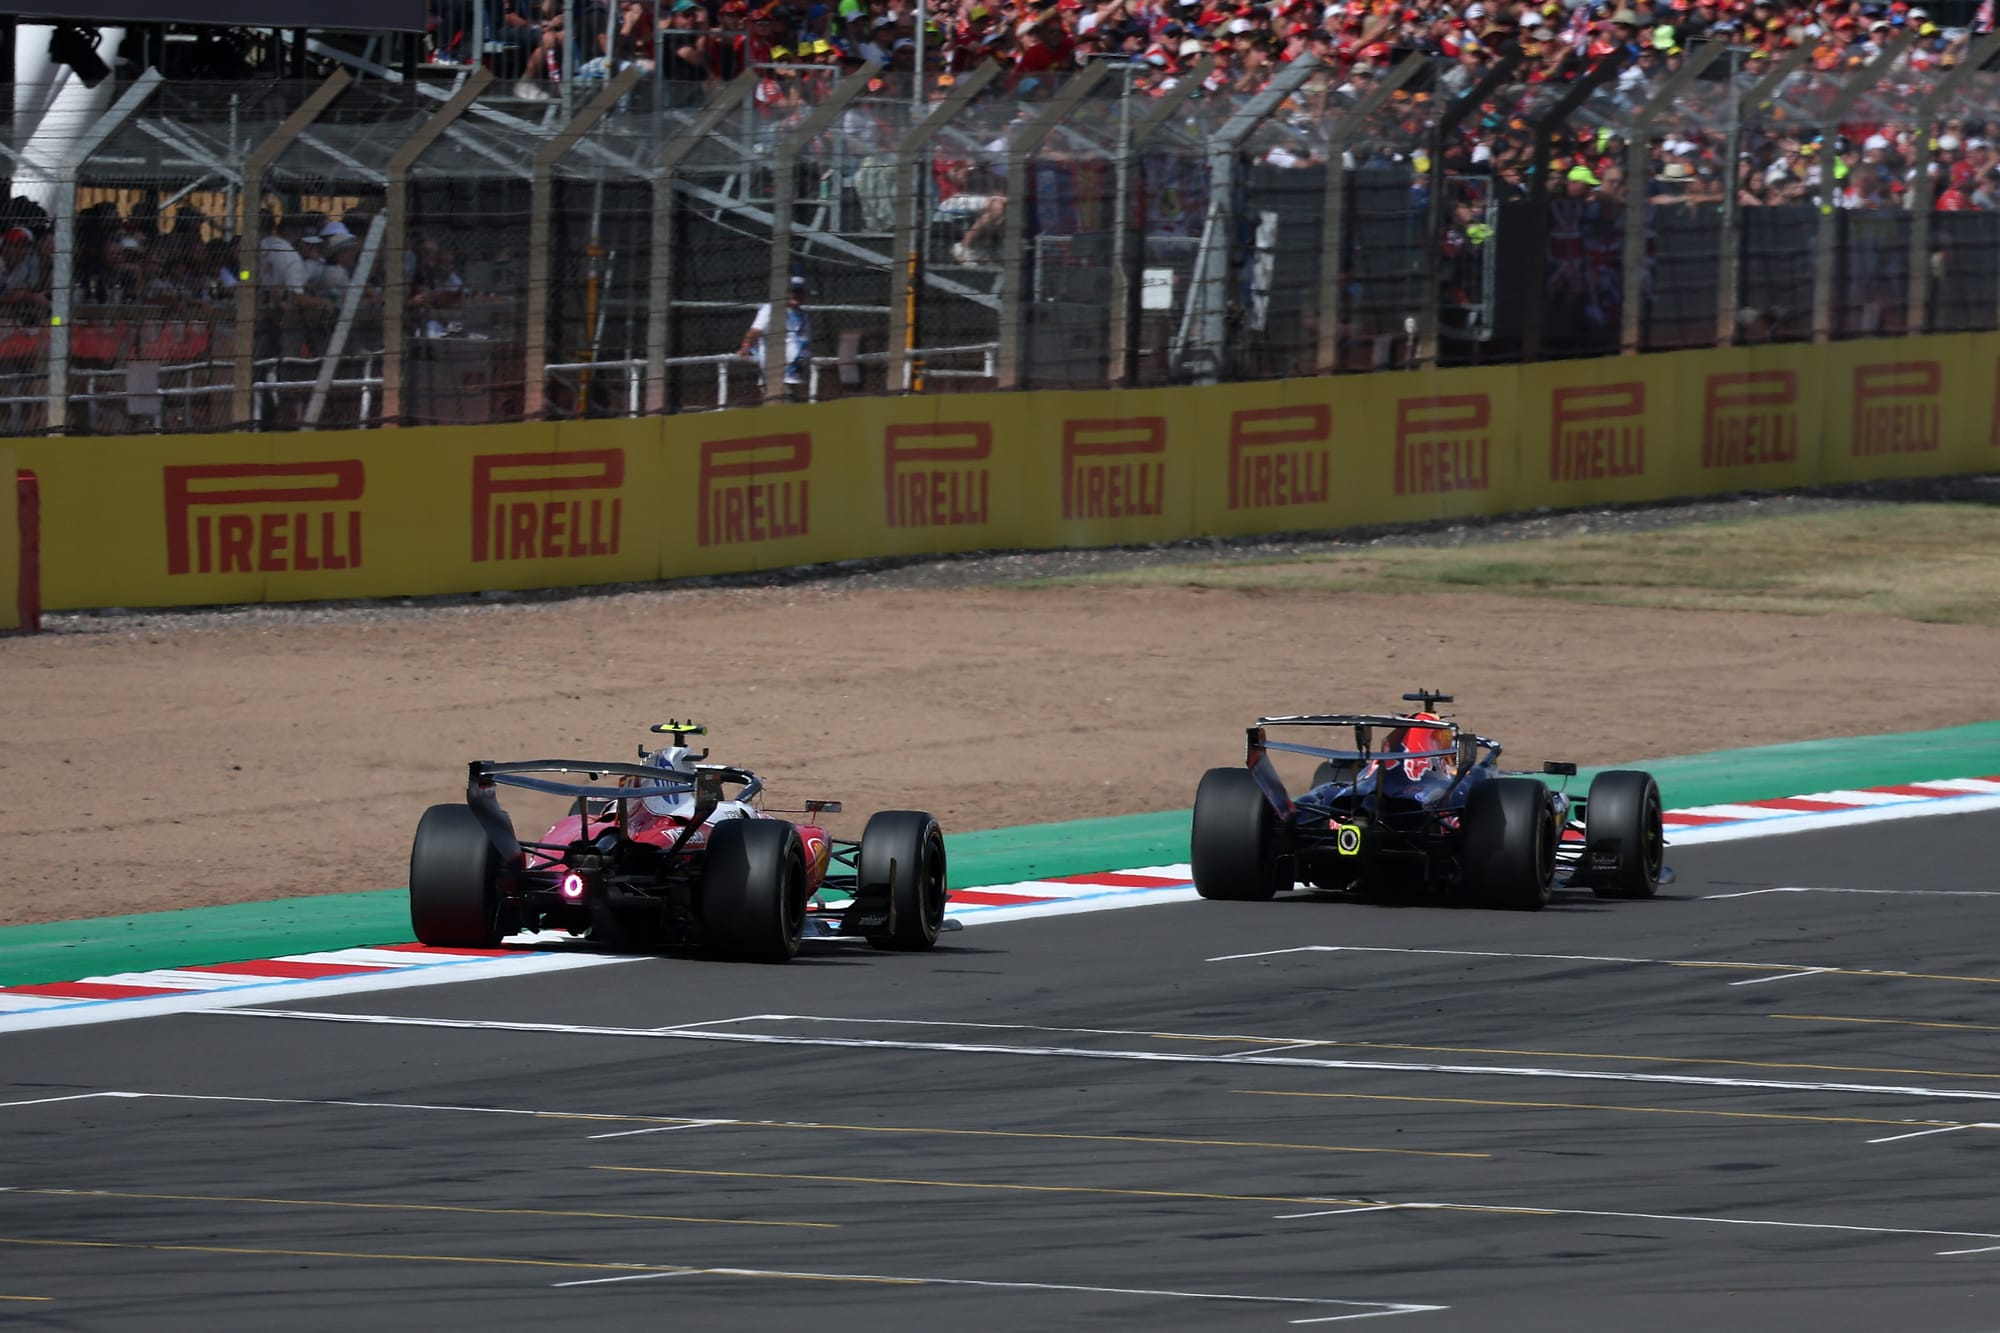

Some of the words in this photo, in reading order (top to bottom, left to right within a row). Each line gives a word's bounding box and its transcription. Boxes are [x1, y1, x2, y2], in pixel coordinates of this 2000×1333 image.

[1228, 403, 1333, 510] PIRELLI
[1394, 393, 1491, 496] PIRELLI
[1550, 381, 1645, 481] PIRELLI
[1704, 370, 1797, 468] PIRELLI
[1852, 360, 1942, 457] PIRELLI
[164, 459, 365, 575] PIRELLI
[472, 448, 625, 562] PIRELLI
[698, 432, 812, 547] PIRELLI
[885, 421, 993, 528] PIRELLI
[1061, 416, 1168, 520] PIRELLI
